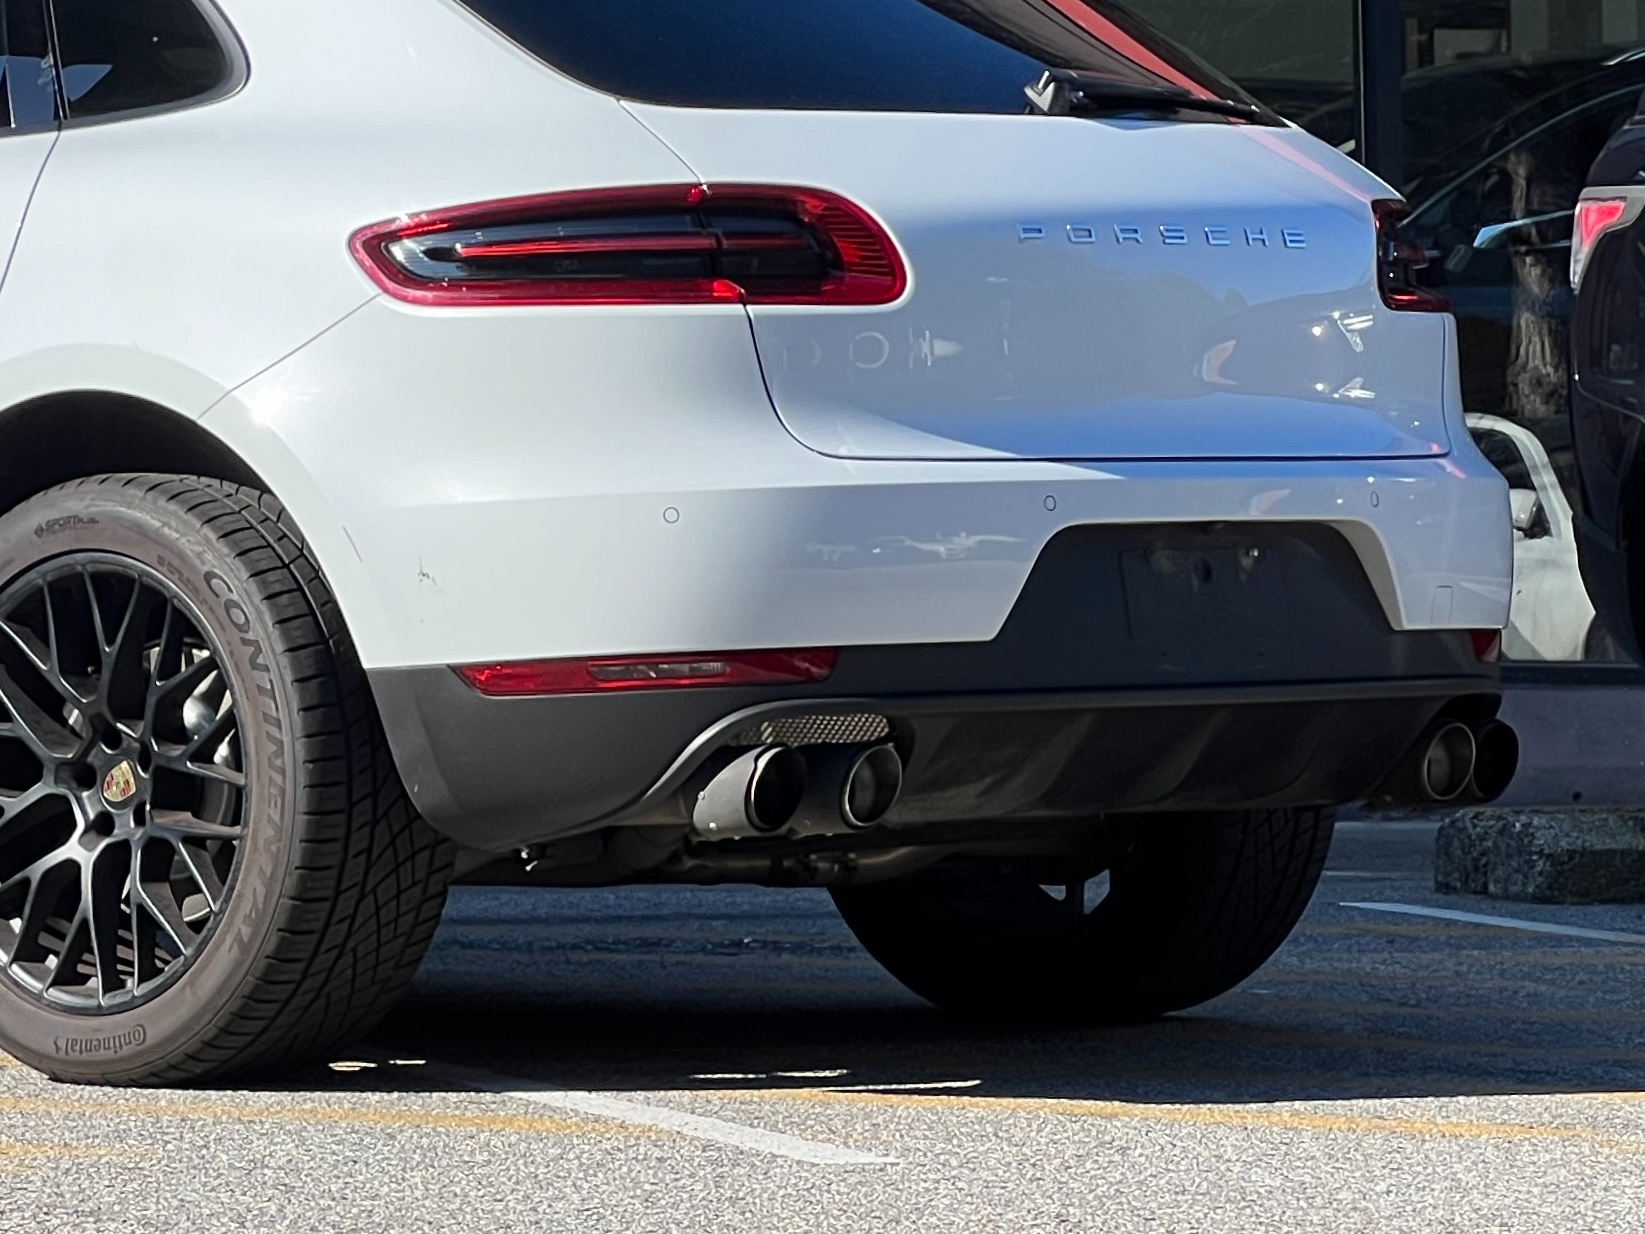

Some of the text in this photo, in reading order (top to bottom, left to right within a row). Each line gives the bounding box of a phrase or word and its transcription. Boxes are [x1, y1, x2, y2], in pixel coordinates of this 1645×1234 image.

[1017, 222, 1307, 249] PORSCHE
[202, 570, 287, 956] CONTINENTAL
[64, 1023, 147, 1056] Continental
